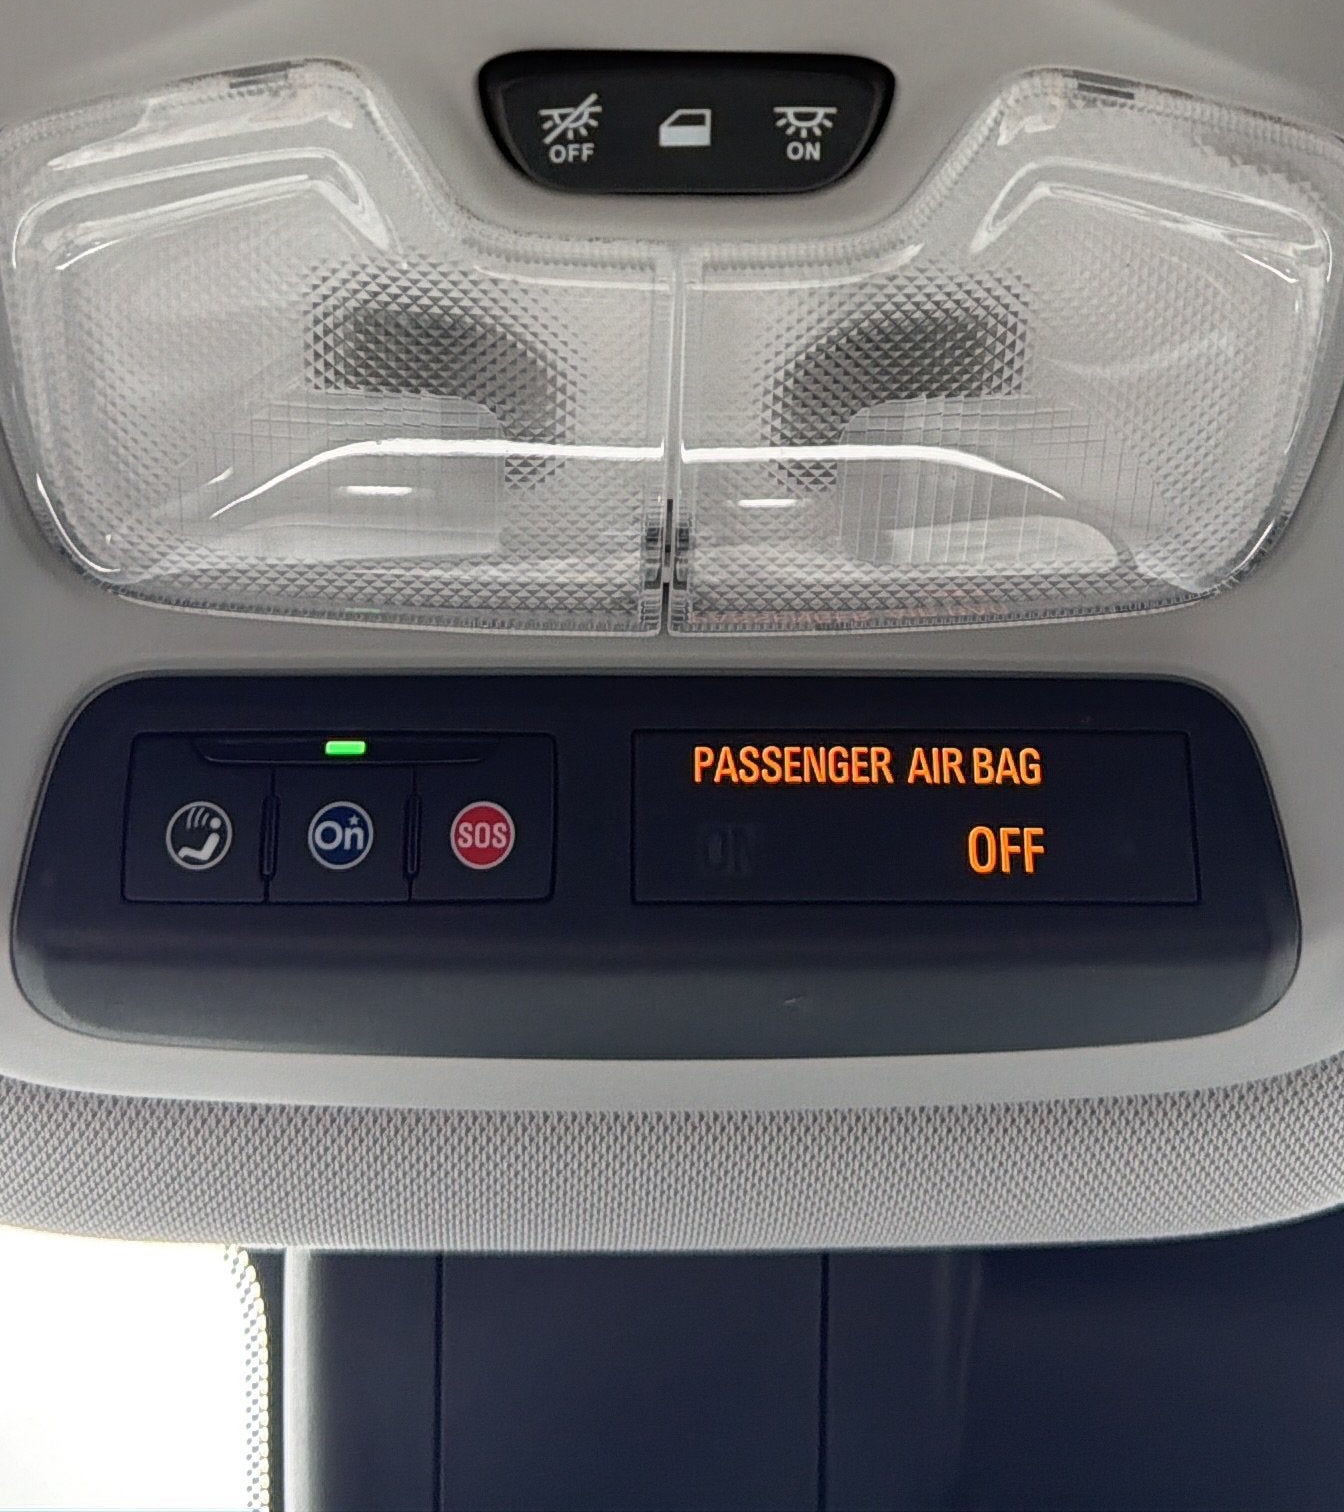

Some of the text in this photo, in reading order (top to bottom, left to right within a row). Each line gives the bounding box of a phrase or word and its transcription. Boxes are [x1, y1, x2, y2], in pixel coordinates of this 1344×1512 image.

[548, 143, 595, 164] OFF
[786, 141, 821, 161] ON
[693, 745, 1043, 786] PASSENGER AIR BAG
[314, 815, 364, 851] On
[457, 821, 508, 849] SOS
[967, 825, 1045, 875] OFF
